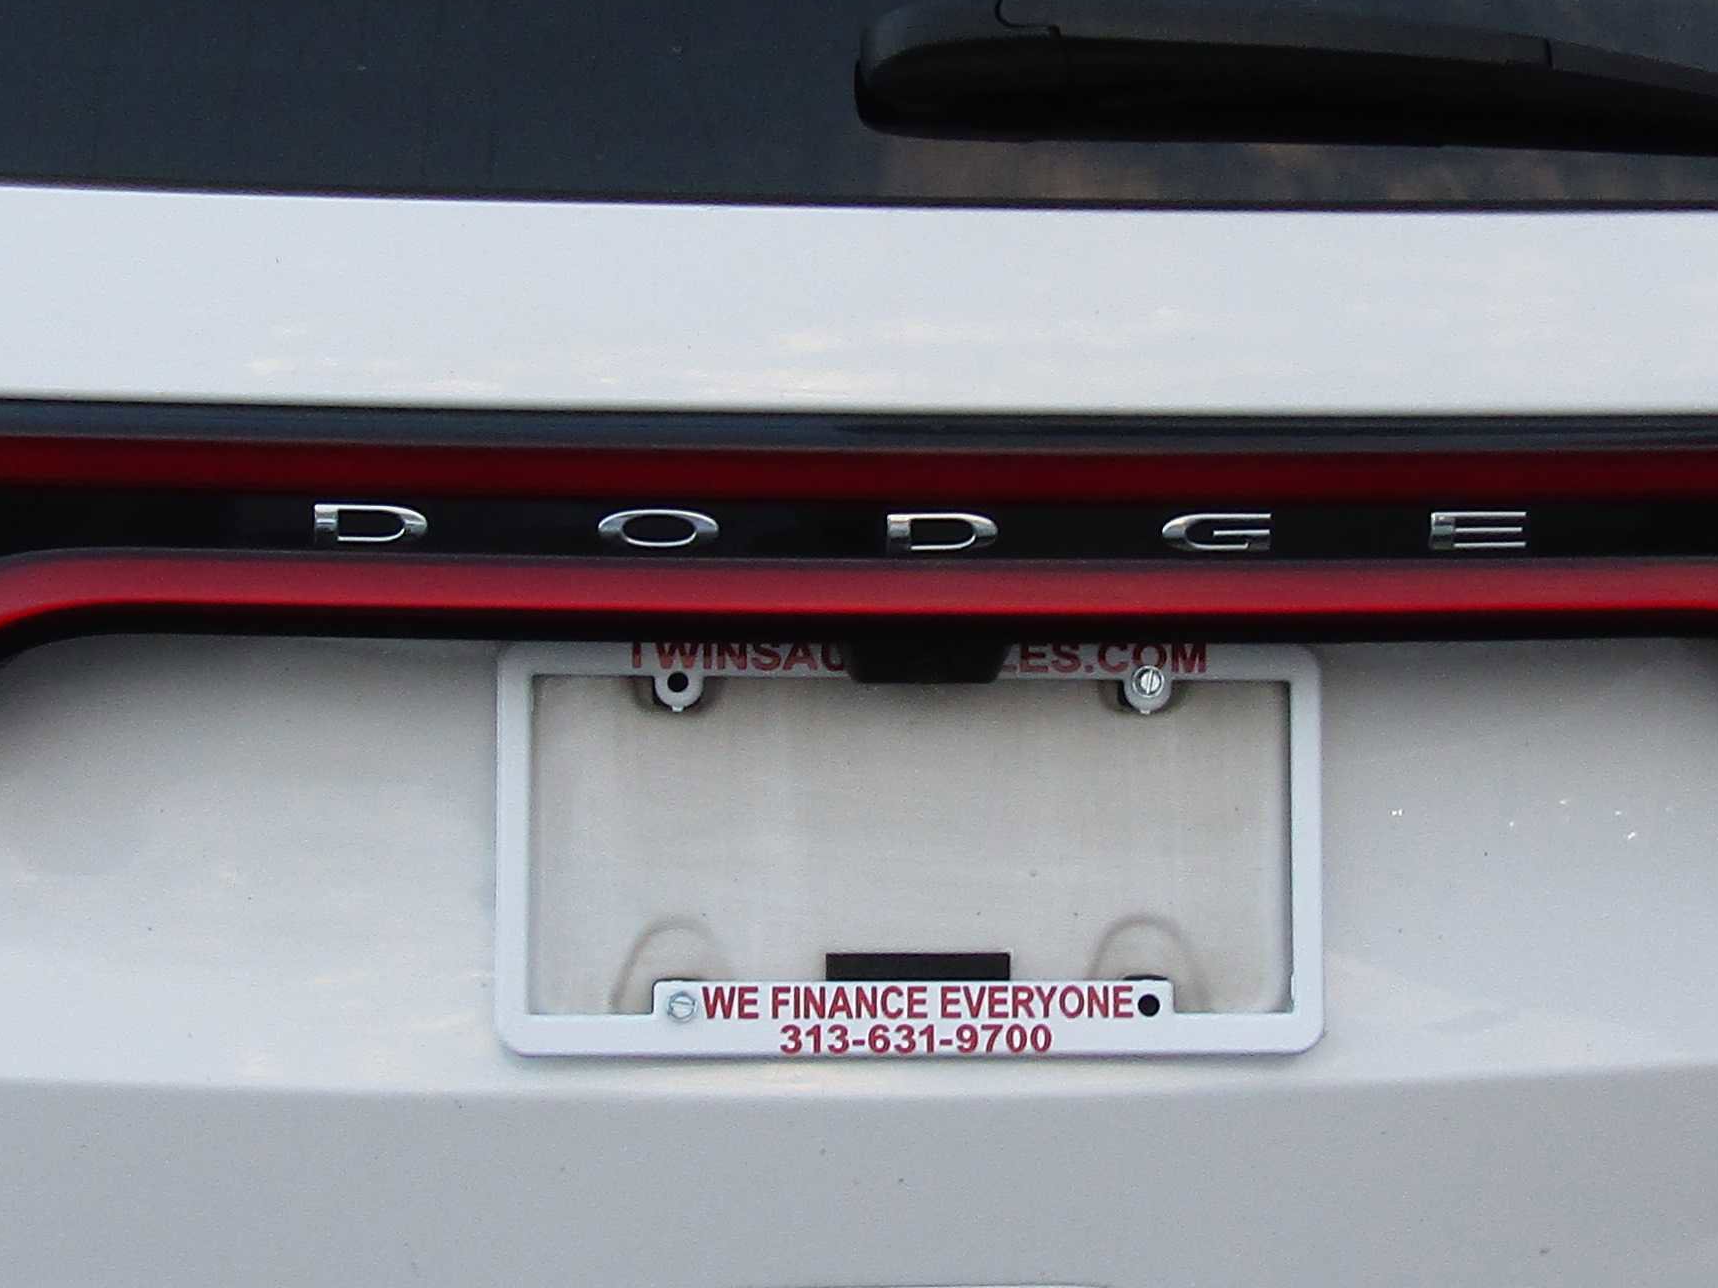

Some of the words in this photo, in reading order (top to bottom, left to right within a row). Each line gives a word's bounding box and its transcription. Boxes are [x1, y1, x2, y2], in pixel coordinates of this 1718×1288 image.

[314, 503, 1527, 552] DODGE
[702, 985, 759, 1020] WE
[771, 985, 927, 1020] FINANCE
[940, 985, 1133, 1020] EVERYONE
[780, 1024, 1052, 1054] 313-631-9700
